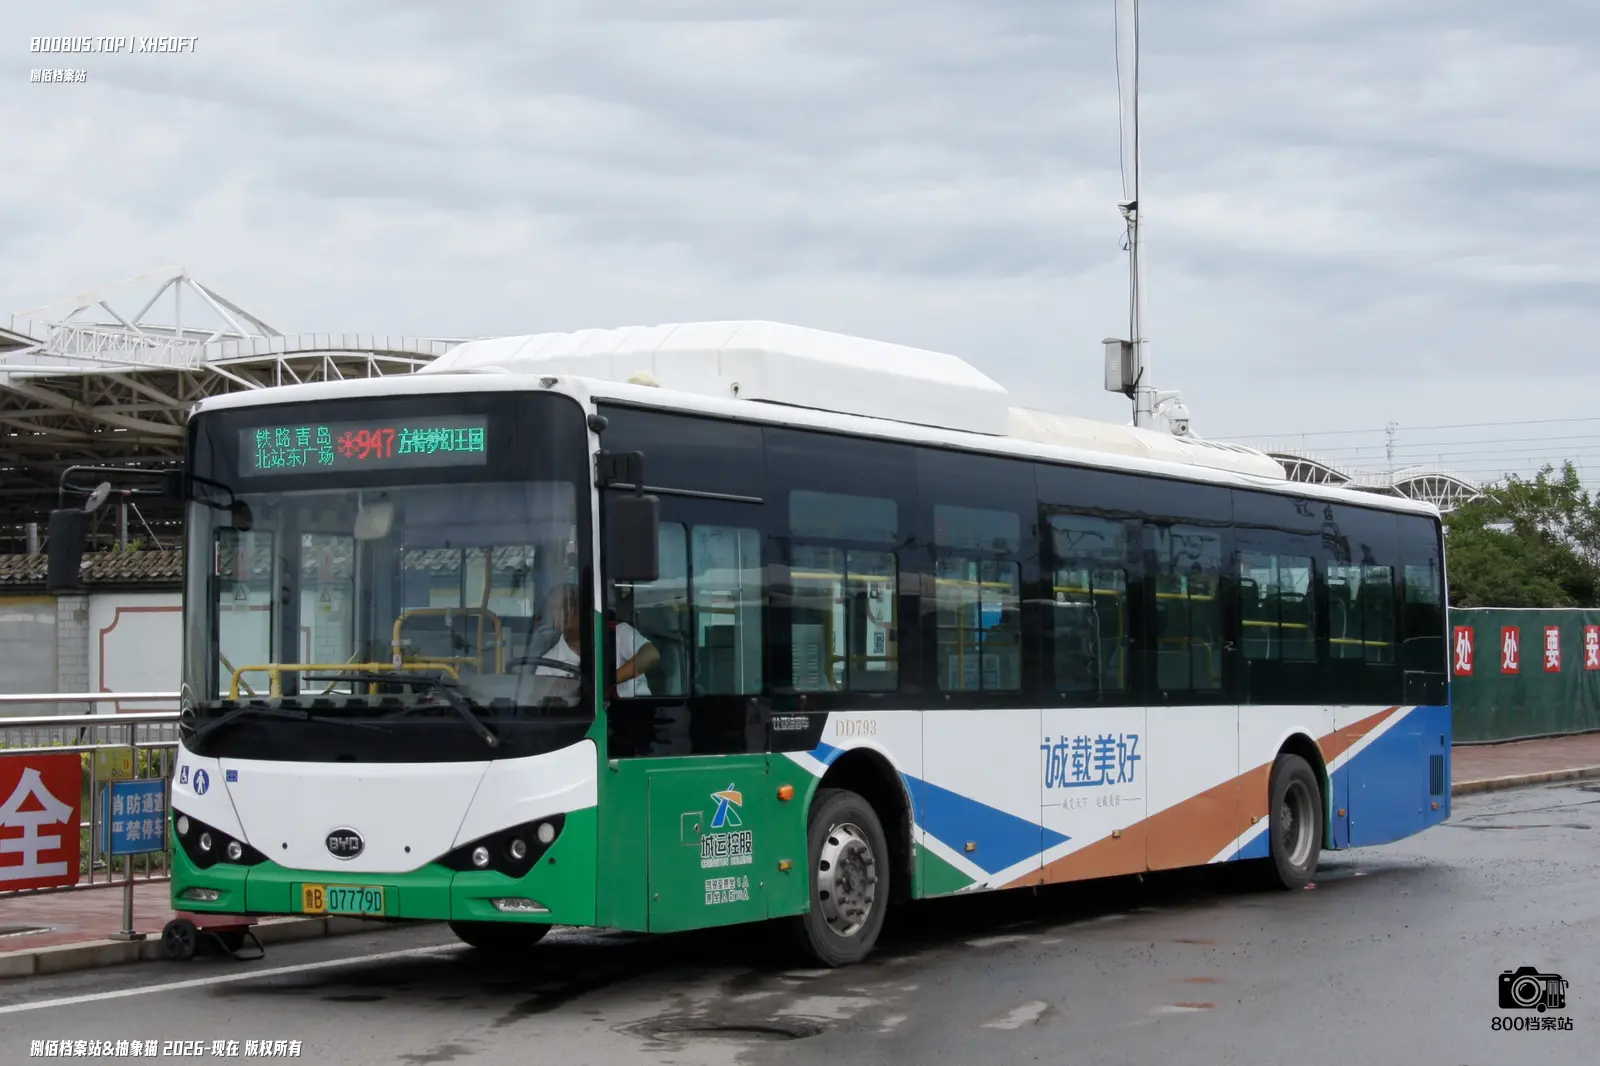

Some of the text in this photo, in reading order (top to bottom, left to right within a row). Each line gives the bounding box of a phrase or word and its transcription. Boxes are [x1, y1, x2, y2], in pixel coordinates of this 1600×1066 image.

[255, 446, 335, 469] 北站东广场
[835, 719, 877, 737] DD793
[1040, 733, 1141, 789] 诚载美好
[0, 767, 75, 881] 全
[329, 836, 359, 851] BYD
[701, 830, 752, 859] 城运控股
